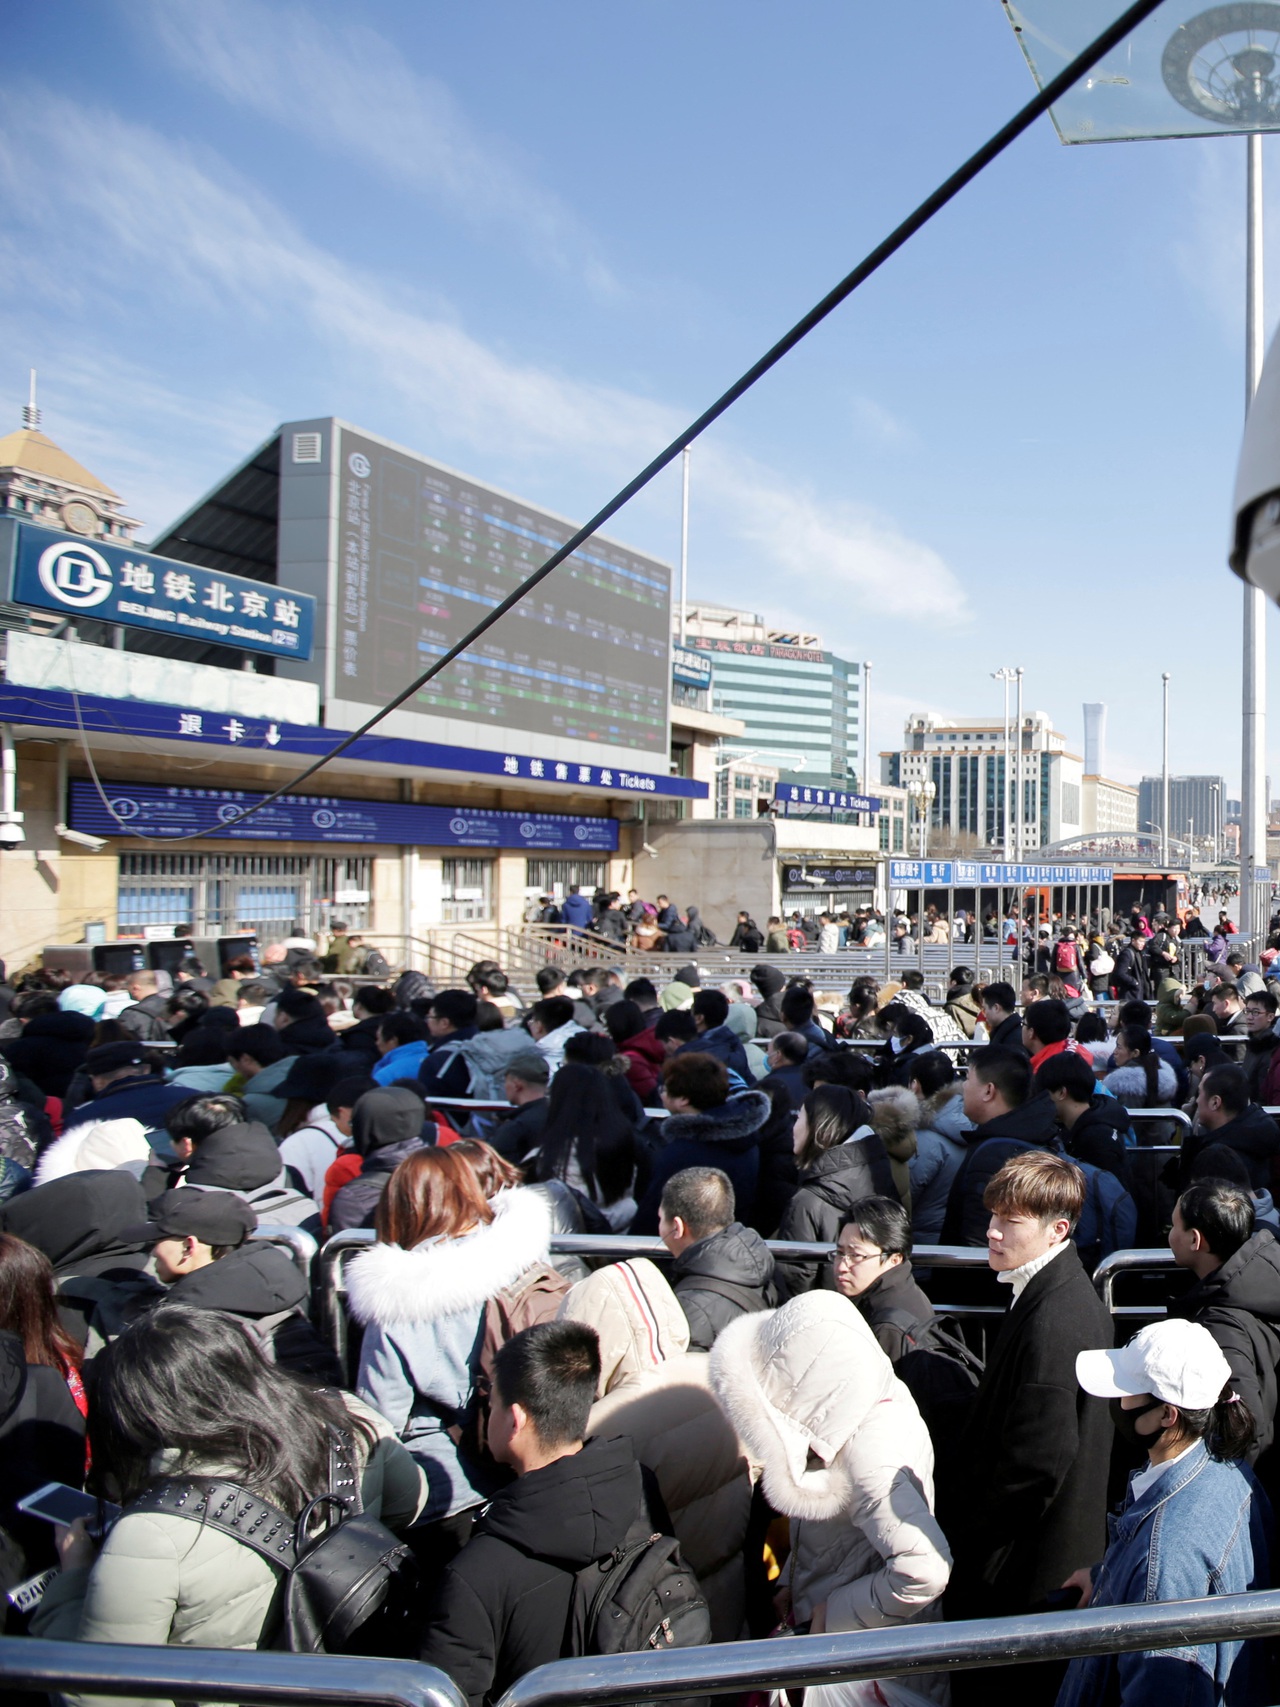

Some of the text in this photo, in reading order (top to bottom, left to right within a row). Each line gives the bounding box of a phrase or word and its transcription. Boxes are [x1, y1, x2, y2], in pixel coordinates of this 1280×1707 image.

[119, 562, 302, 629] 地铁北京站
[117, 600, 176, 622] BEIJING
[177, 612, 231, 636] Railway
[230, 624, 272, 643] Station
[178, 713, 246, 742] 退卡
[503, 756, 656, 791] 地铁售票处 Tickets
[790, 785, 870, 810] 地铁售票处 Tickets
